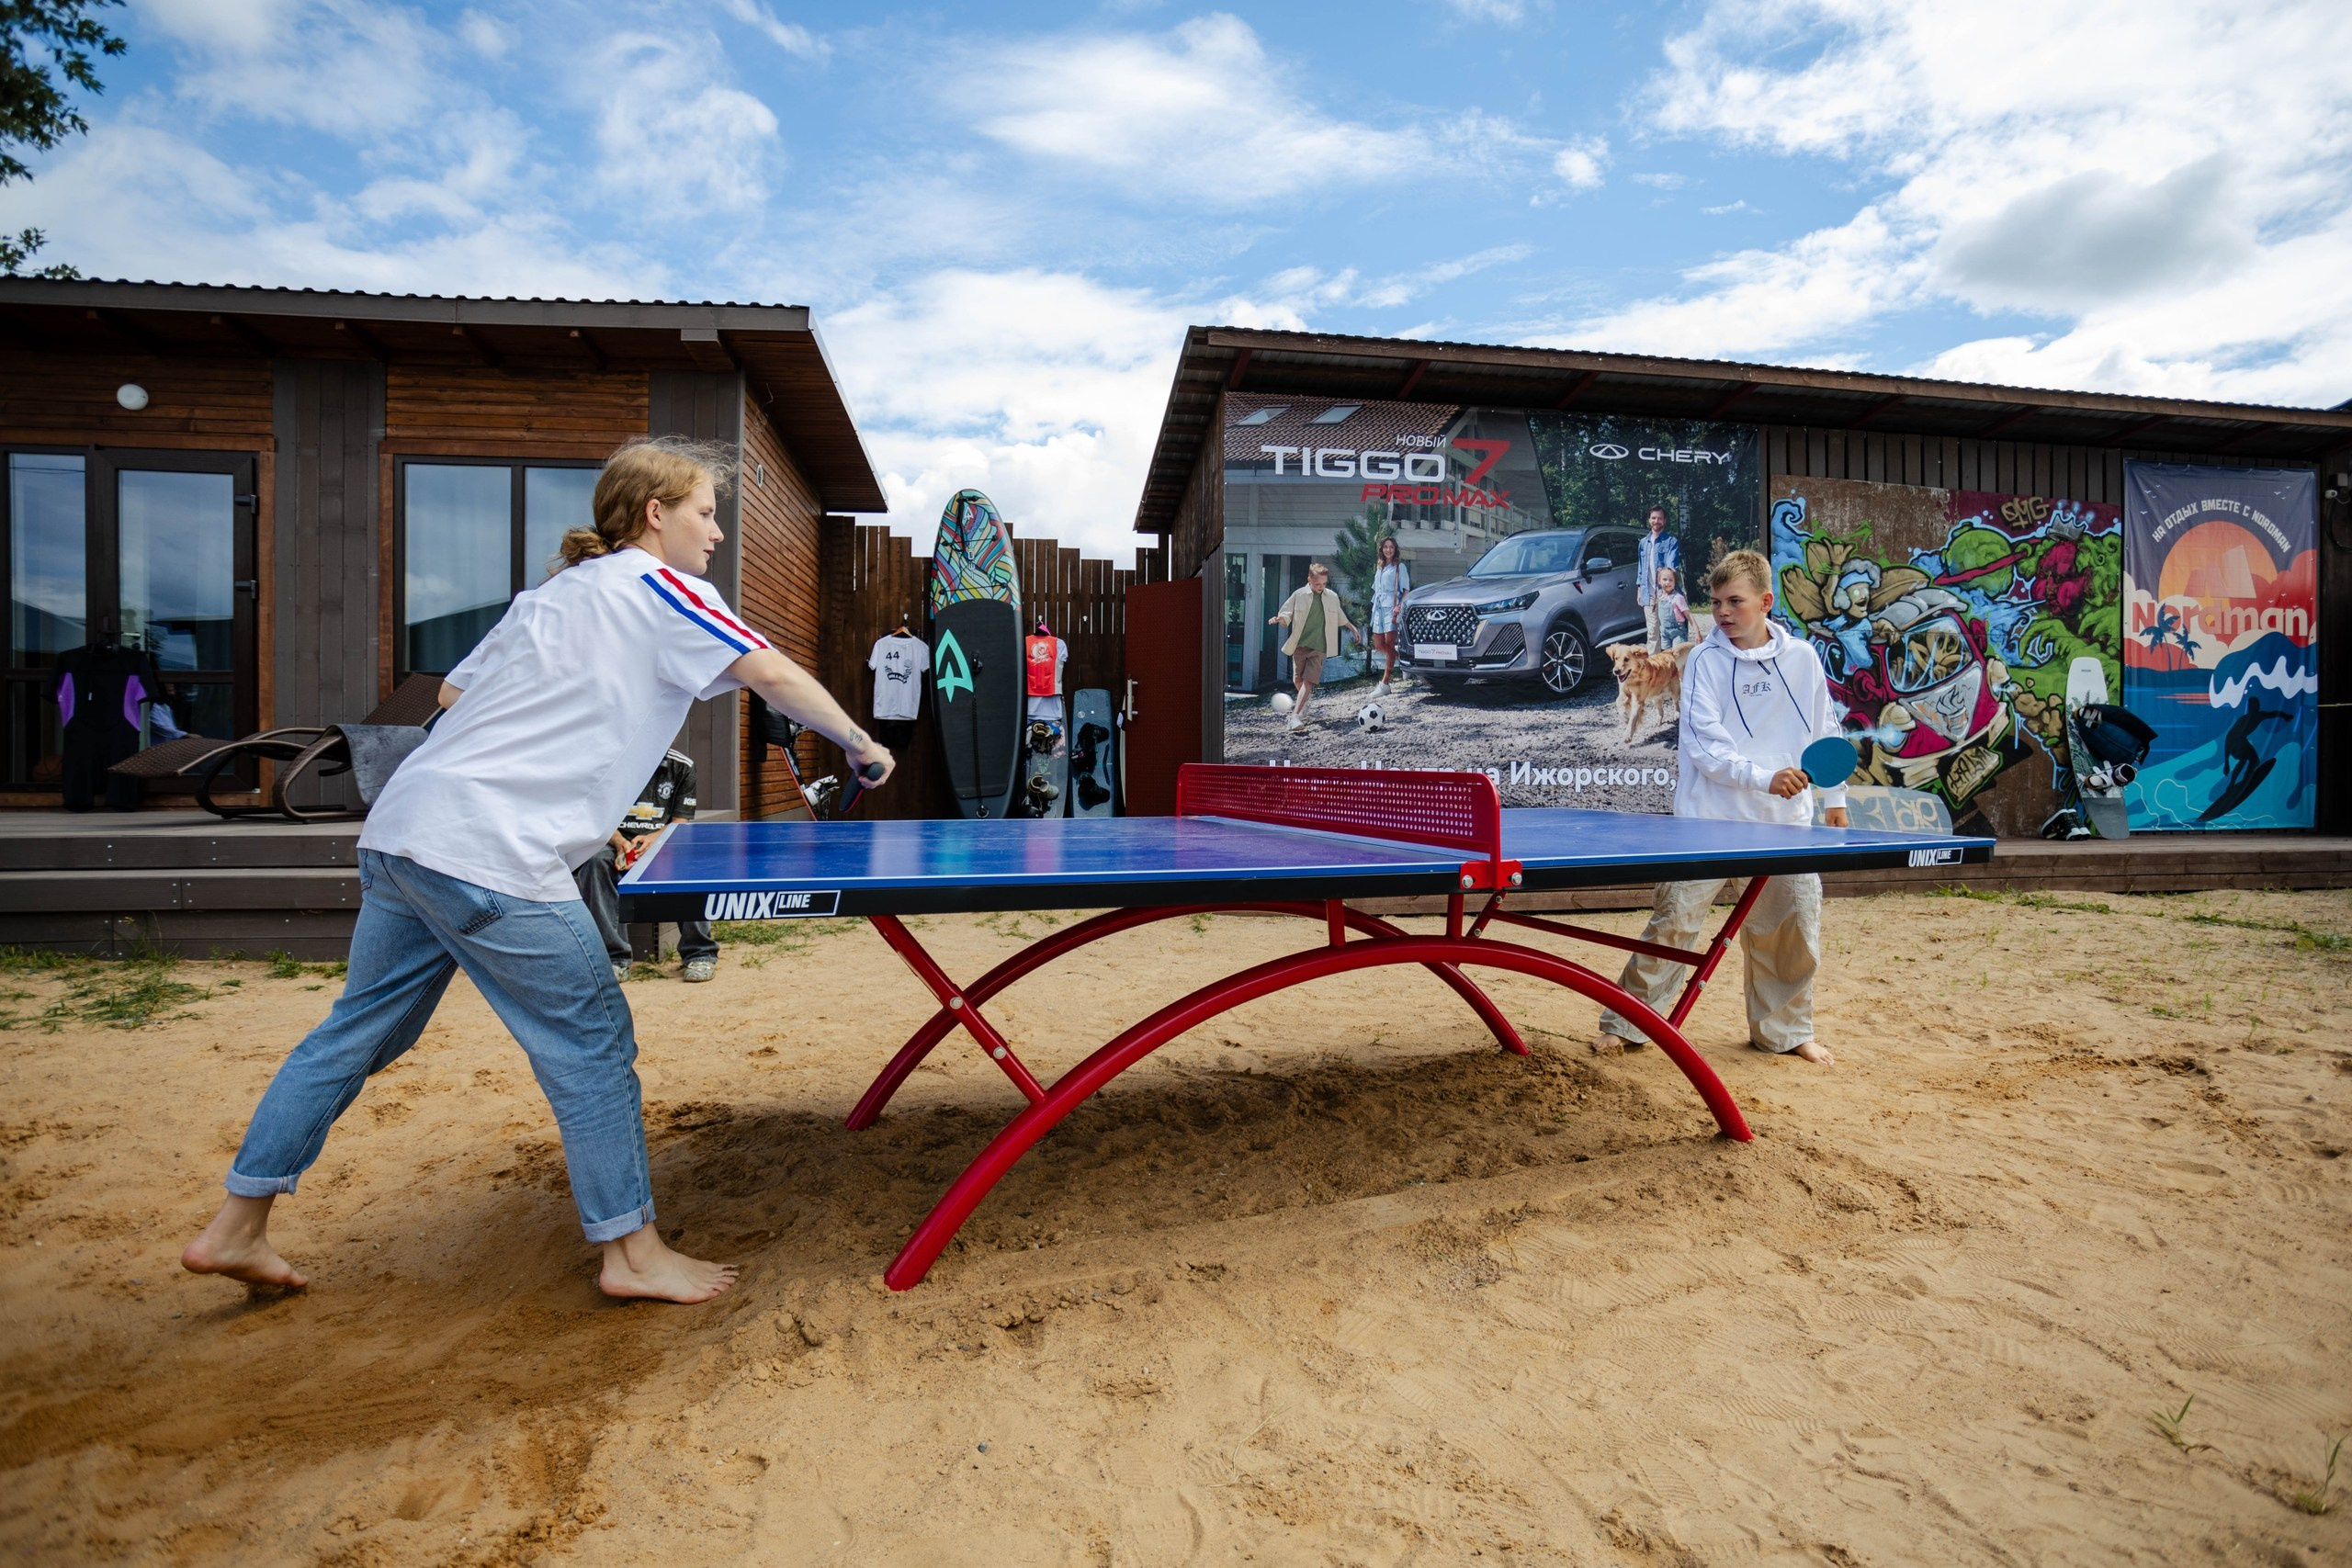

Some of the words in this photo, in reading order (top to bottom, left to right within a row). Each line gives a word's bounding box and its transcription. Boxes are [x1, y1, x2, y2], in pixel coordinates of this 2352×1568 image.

[1396, 434, 1447, 448] НОВЫЙ
[1261, 445, 1446, 483] TIGGO
[1452, 437, 1510, 484] 7
[1638, 447, 1730, 465] CHERY
[2152, 525, 2166, 543] НА
[2164, 502, 2199, 530] ОТДЫХ
[2201, 499, 2241, 514] ВМЕСТЕ
[2243, 505, 2251, 517] С
[2251, 510, 2291, 553] NORDMAN
[2132, 602, 2308, 637] Nordman
[886, 651, 900, 660] 44
[1510, 761, 1677, 793] Ижорского,
[1908, 849, 1938, 867] UNIX
[1938, 850, 1952, 860] LINE
[705, 892, 775, 920] UNIX
[778, 894, 811, 908] LINE
